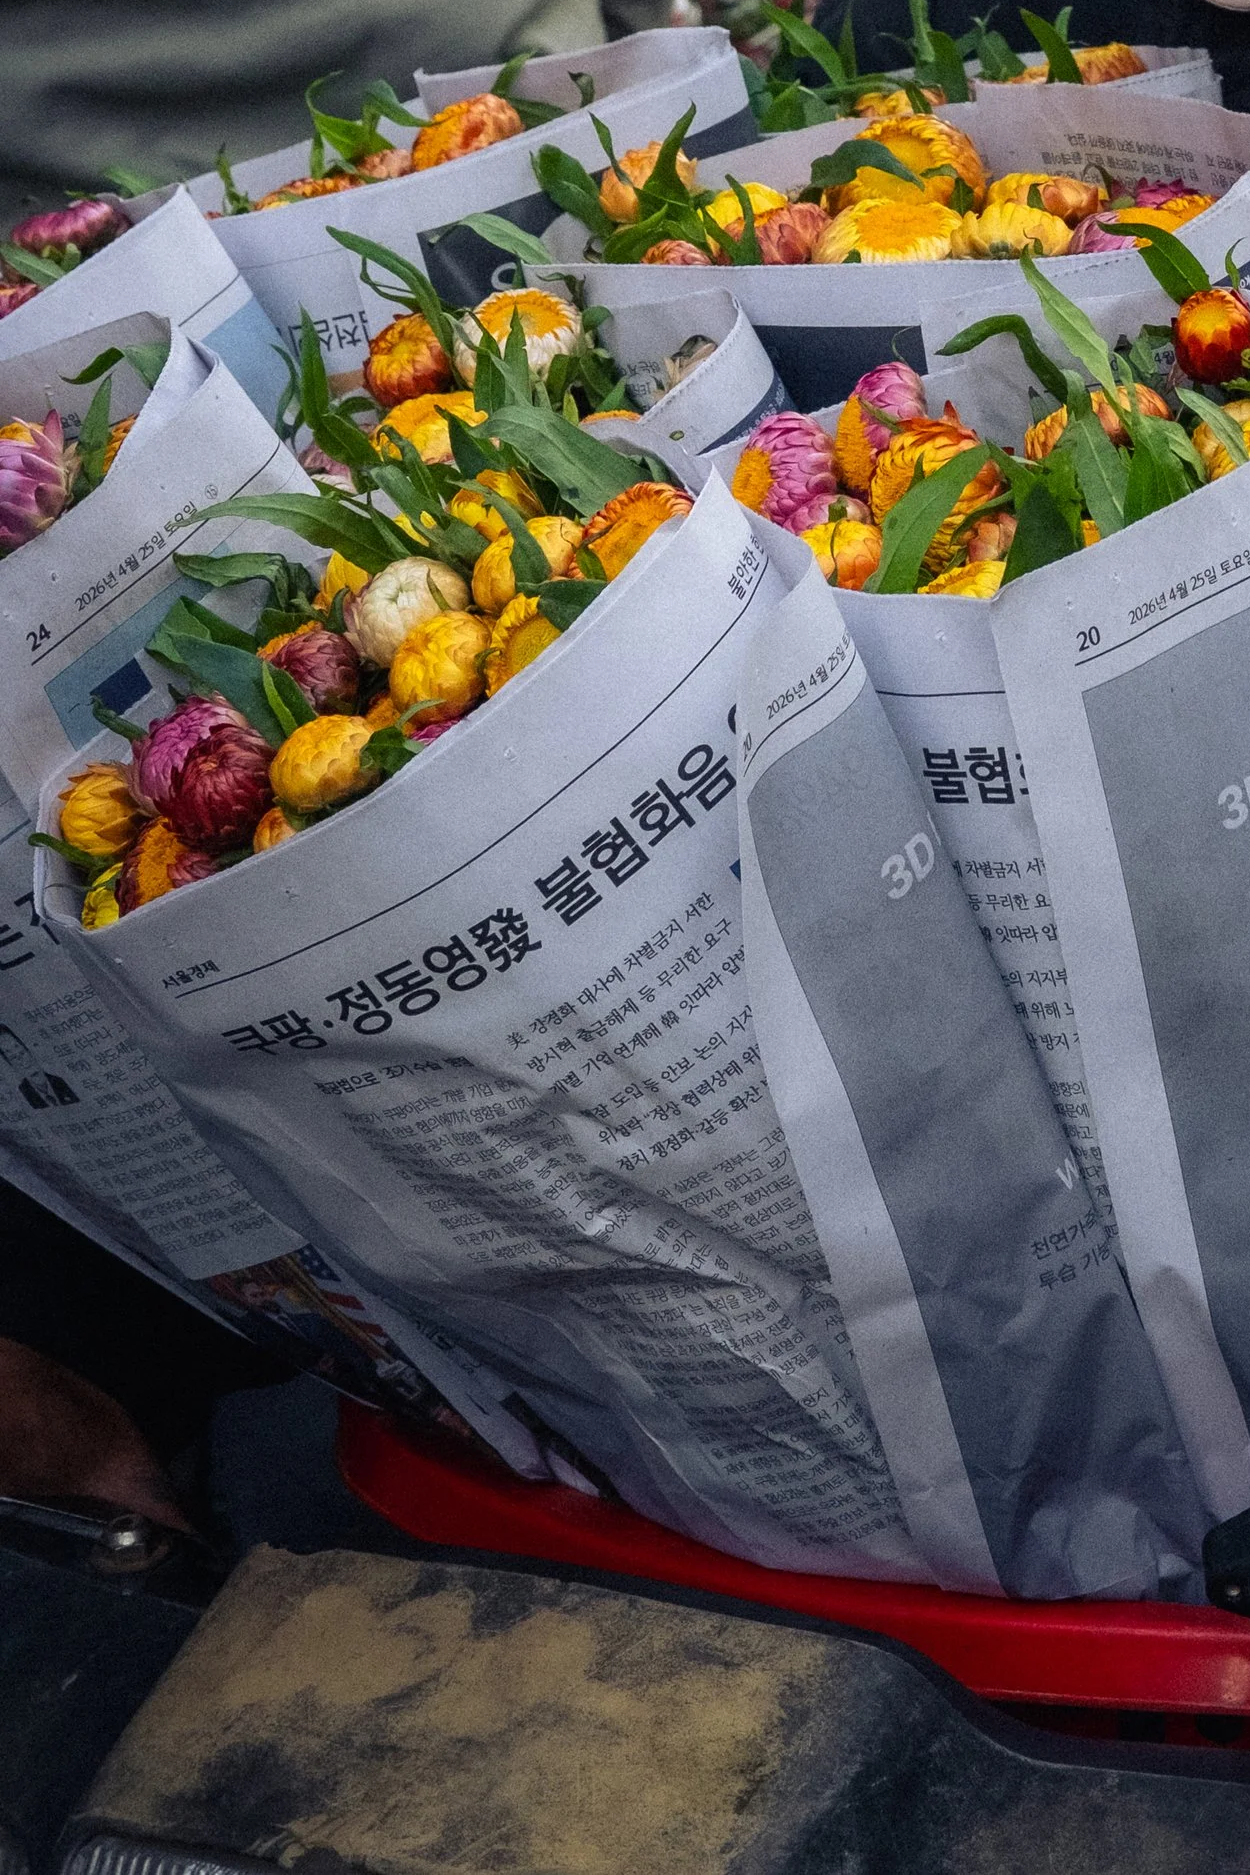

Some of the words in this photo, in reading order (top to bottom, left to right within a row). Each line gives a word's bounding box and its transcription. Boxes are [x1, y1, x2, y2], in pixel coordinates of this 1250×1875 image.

[74, 571, 118, 612] 2026년
[117, 553, 141, 577] 4월
[138, 531, 166, 561] 25일
[727, 550, 758, 601] 불안한
[1127, 593, 1169, 627] 2026년
[1168, 577, 1190, 603] 4월
[1188, 566, 1219, 594] 25일
[25, 623, 51, 652] 24
[1076, 626, 1101, 654] 20
[765, 681, 807, 722] 2026년
[808, 662, 830, 688] 4월
[827, 644, 848, 670] 25일
[532, 742, 738, 928] 불협화음
[880, 838, 936, 901] 3D
[966, 859, 1021, 881] 차별금지
[986, 892, 1029, 912] 무리한
[995, 925, 1038, 945] 잇따라
[162, 959, 220, 989] 서울경제
[528, 1001, 578, 1035] 강경화
[576, 965, 626, 1006] 대사에
[623, 918, 685, 972] 차별금지
[683, 891, 715, 923] 서한
[525, 1036, 576, 1073] 방시혁
[637, 984, 656, 1003] 등
[656, 945, 704, 988] 무리한
[703, 917, 732, 951] 요구
[552, 1070, 583, 1097] 개별
[581, 1050, 614, 1076] 기업
[613, 1021, 663, 1059] 연계해
[678, 971, 724, 1015] 잇따라
[1038, 1033, 1071, 1053] 방지
[610, 1082, 643, 1109] 도입
[642, 1077, 660, 1094] 등
[660, 1056, 696, 1084] 안보
[692, 1031, 728, 1061] 논의
[681, 1059, 744, 1108] 협력상태
[616, 1148, 650, 1174] 정치
[727, 1085, 763, 1113] 확산
[723, 1166, 766, 1193] 않다고
[740, 1173, 797, 1207] 절차대로
[742, 1195, 798, 1228] 협상대로
[782, 1209, 813, 1232] 논의
[1038, 1261, 1078, 1293] 투습
